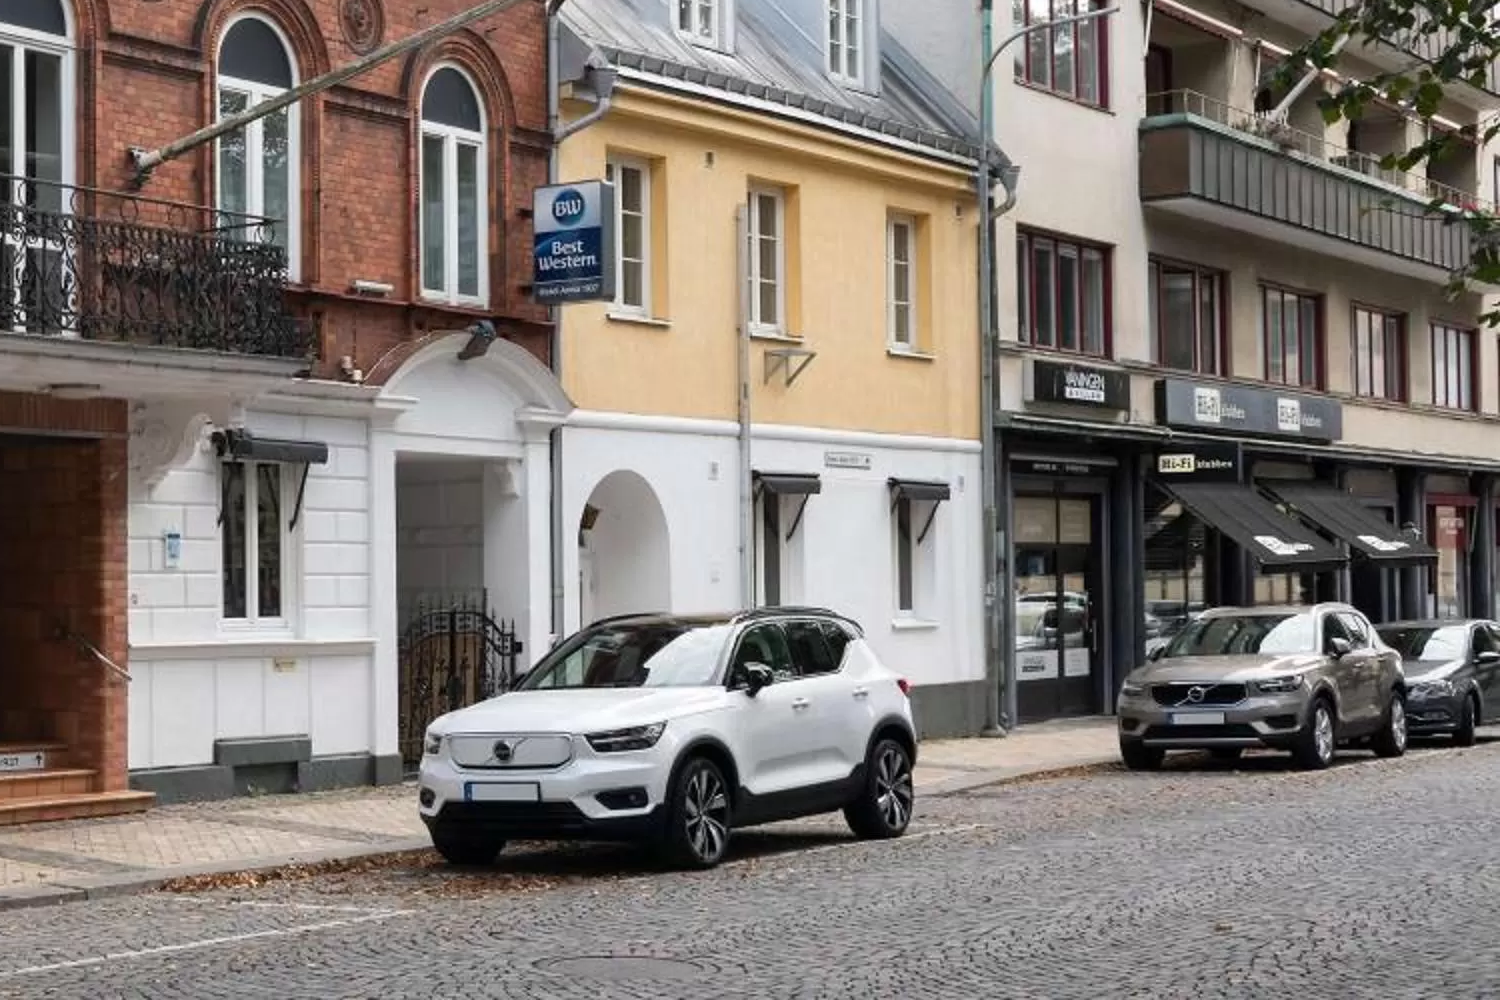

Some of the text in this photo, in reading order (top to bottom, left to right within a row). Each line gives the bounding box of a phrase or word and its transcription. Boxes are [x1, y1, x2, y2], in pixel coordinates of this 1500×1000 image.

[555, 200, 581, 216] BW
[552, 241, 584, 255] Best
[538, 254, 596, 271] Western
[1161, 457, 1191, 469] Hi-Fi
